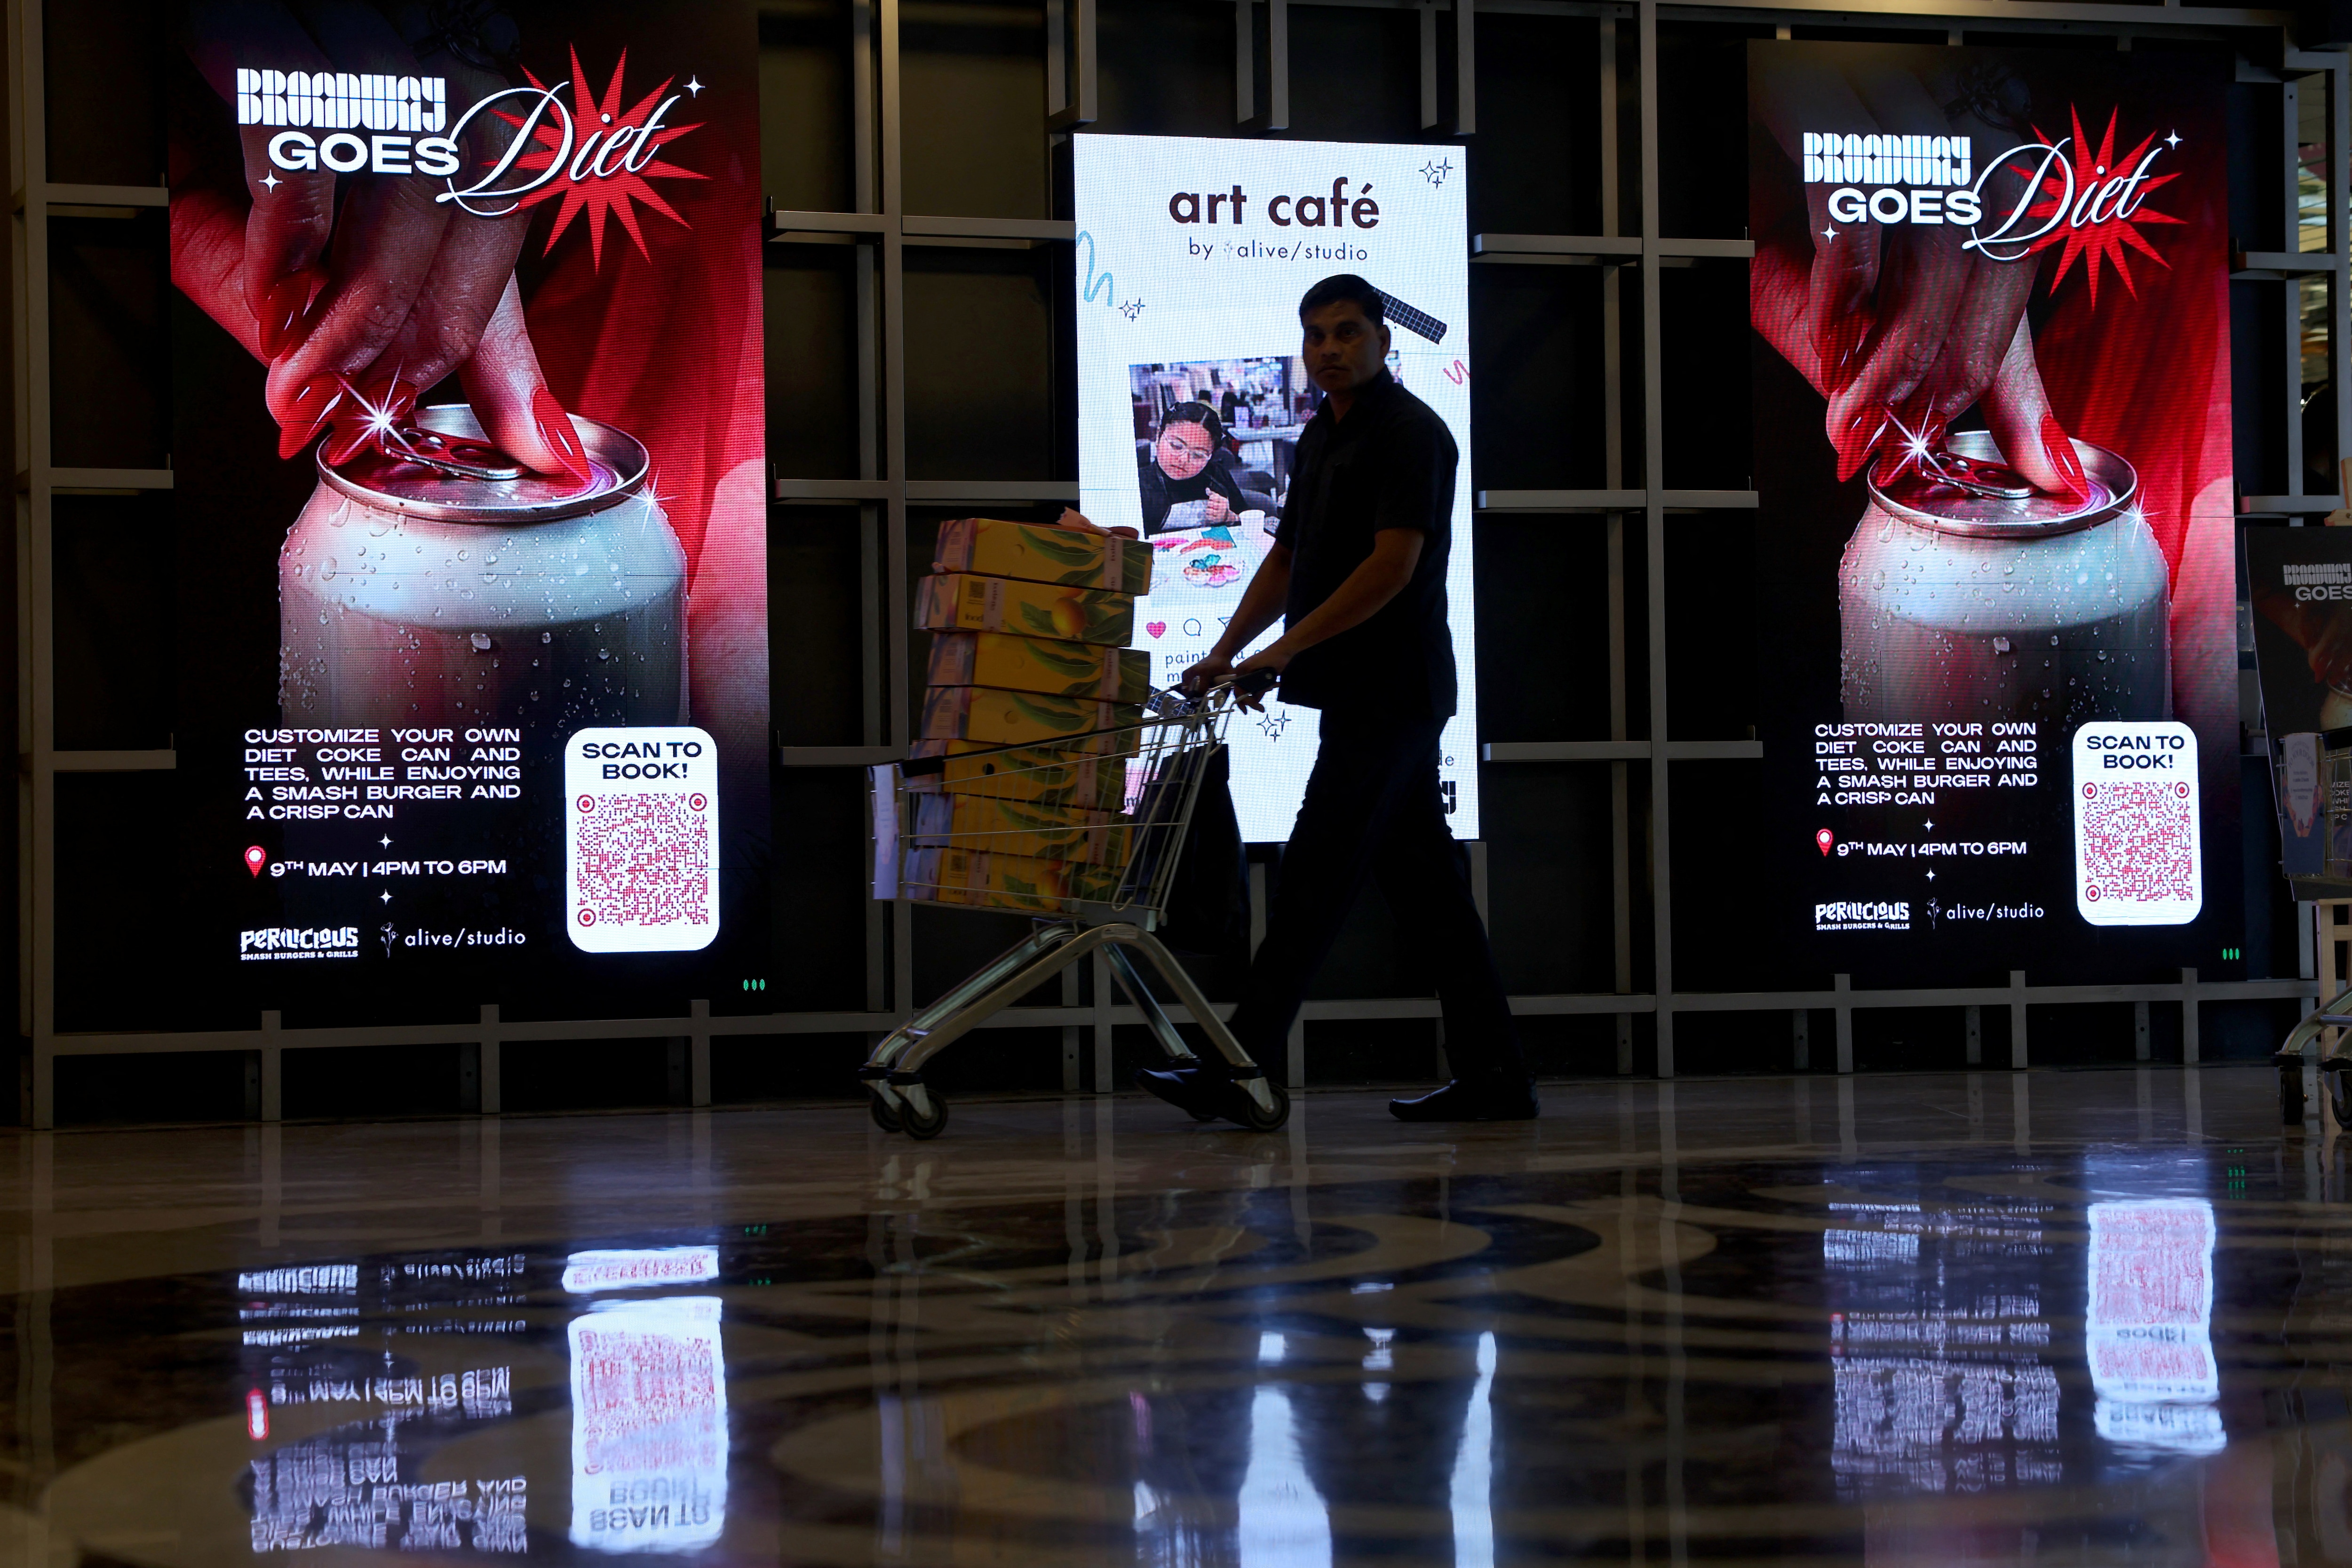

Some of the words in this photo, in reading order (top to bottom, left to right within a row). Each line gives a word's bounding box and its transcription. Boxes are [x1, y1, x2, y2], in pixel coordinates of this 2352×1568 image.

[237, 68, 446, 133] BROADWAY
[268, 132, 460, 177] GOES
[436, 81, 681, 216] Diet
[1803, 132, 1971, 186] BROADWAY
[1169, 185, 1247, 224] art
[1268, 176, 1379, 229] café
[1828, 187, 1982, 225] GOES
[1962, 137, 2162, 260] Diet
[1189, 237, 1214, 260] by
[1237, 239, 1367, 261] alive/studio
[245, 729, 379, 743] CUSTOMIZE
[391, 729, 453, 742] YOUR
[465, 729, 519, 742] OWN
[1815, 723, 1923, 737] CUSTOMIZE
[1932, 723, 1982, 736] YOUR
[1992, 723, 2036, 736] OWN
[582, 743, 660, 758] SCAN
[666, 742, 701, 757] TO
[1816, 741, 1857, 755] DIET
[1873, 740, 1924, 754] COKE
[1941, 740, 1980, 753] CAN
[1997, 740, 2036, 753] AND
[2087, 736, 2150, 749] SCAN
[2155, 736, 2184, 749] TO
[245, 749, 296, 762] DIET
[317, 748, 381, 762] COKE
[401, 748, 450, 762] CAN
[470, 748, 520, 761] AND
[2104, 755, 2173, 769] BOOK!
[1816, 758, 1867, 771] TEES,
[1877, 758, 1935, 770] WHILE
[1946, 756, 2037, 770] ENJOYING
[245, 767, 309, 782] TEES,
[322, 767, 394, 780] WHILE
[407, 766, 520, 780] ENJOYING
[603, 764, 687, 779] BOOK!
[1817, 776, 1831, 788] A
[1839, 775, 1906, 788] SMASH
[1914, 774, 1990, 788] BURGER
[1998, 774, 2037, 786] AND
[245, 787, 263, 801] A
[272, 786, 357, 800] SMASH
[367, 785, 461, 800] BURGER
[470, 785, 520, 798] AND
[1817, 793, 1831, 805] A
[1835, 792, 1891, 804] CRISP
[1895, 792, 1934, 805] CAN
[247, 806, 264, 820] A
[270, 805, 340, 819] CRISP
[344, 805, 393, 819] CAN
[1867, 843, 1907, 856] MAY
[1918, 843, 1957, 856] 4PM
[1959, 843, 1984, 855] TO
[1987, 842, 2026, 855] 6PM
[309, 862, 358, 876] MAY
[372, 861, 420, 876] 4PM
[423, 861, 454, 875] TO
[457, 860, 507, 874] 6PM
[1947, 902, 2044, 921] alive/studio
[1884, 922, 1910, 930] GRILLS
[405, 927, 526, 948] alive/studio
[274, 951, 316, 960] BURGERS
